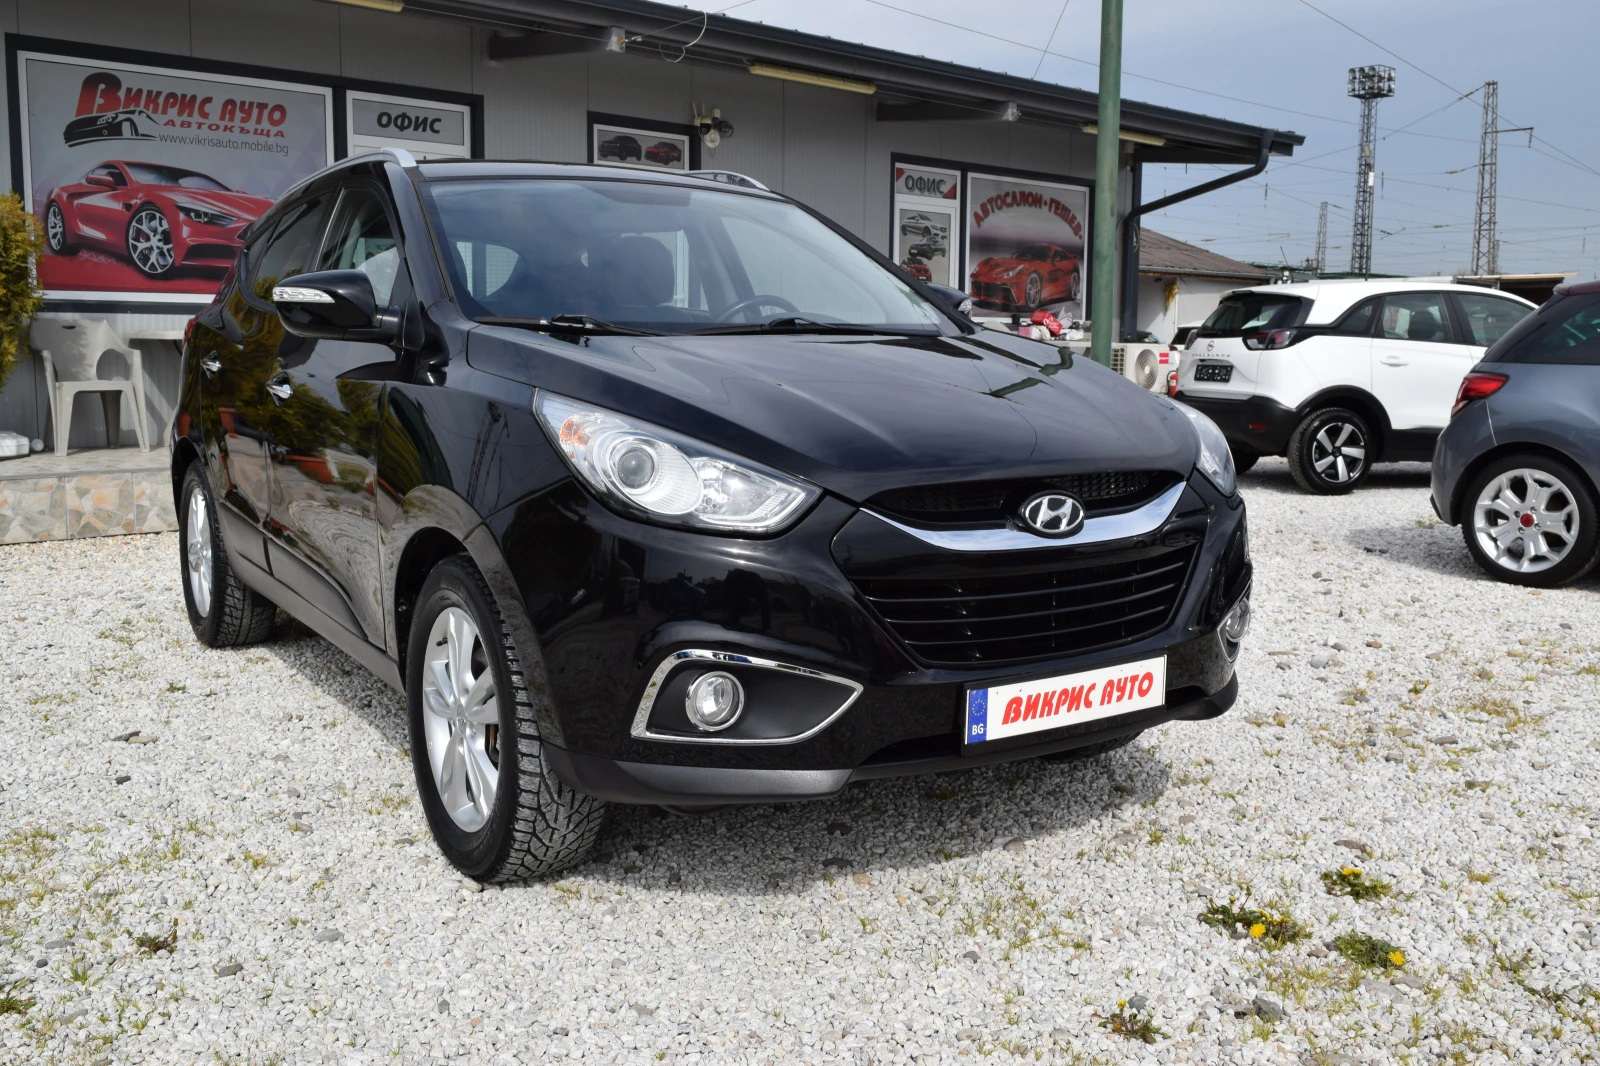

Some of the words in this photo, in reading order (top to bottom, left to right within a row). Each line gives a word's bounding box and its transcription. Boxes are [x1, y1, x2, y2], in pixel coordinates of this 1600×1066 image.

[219, 98, 287, 127] АУТО
[377, 112, 441, 134] ОФИС
[163, 119, 285, 138] АВТОКЪЩА
[158, 133, 289, 156] www.vikrisauto.mobile.bg
[905, 174, 946, 195] ОФИС
[1002, 682, 1096, 725] ВИКРИС
[1100, 671, 1153, 706] АУТО
[972, 723, 984, 735] BG
